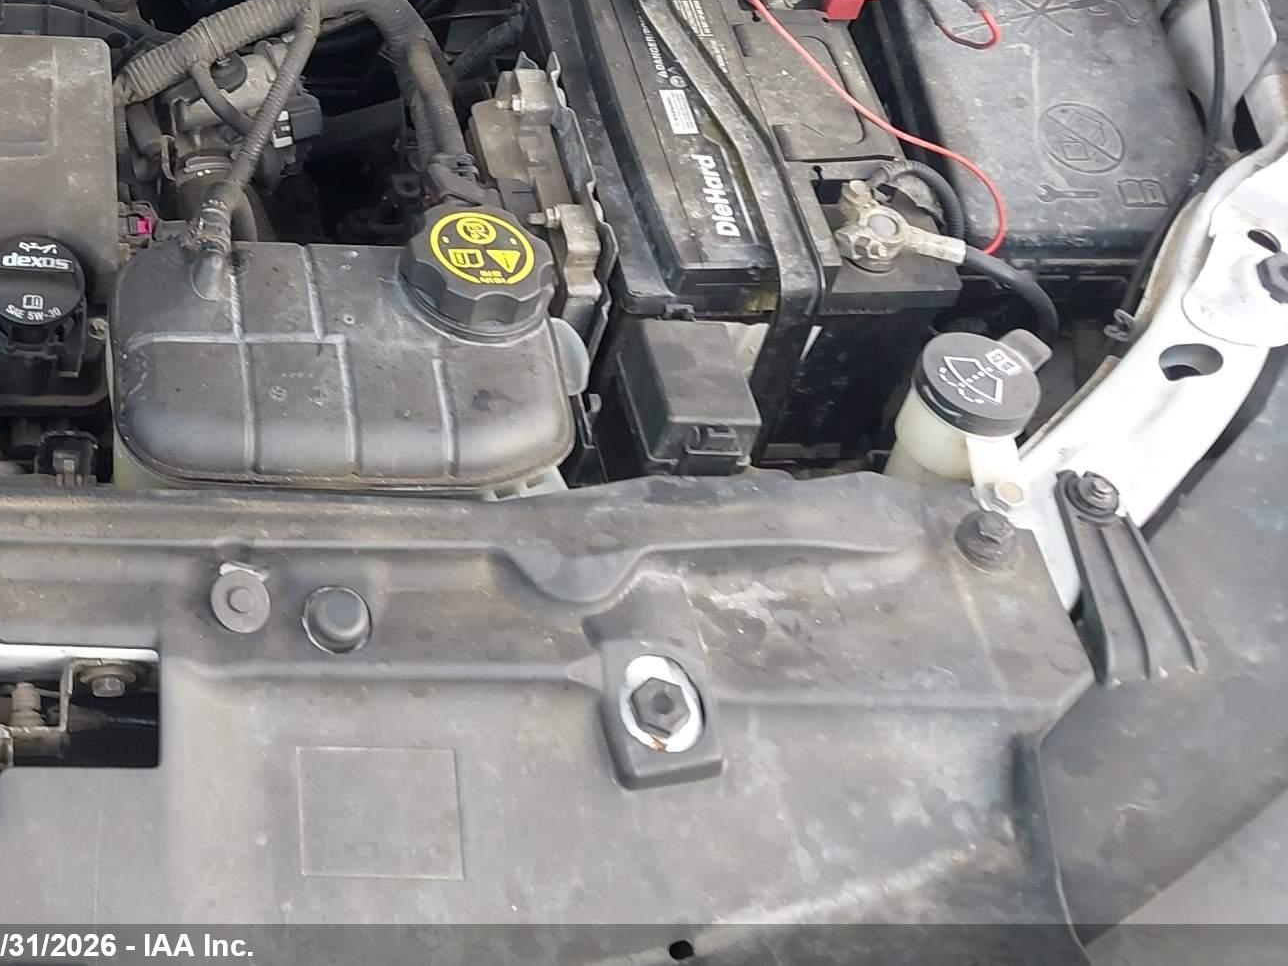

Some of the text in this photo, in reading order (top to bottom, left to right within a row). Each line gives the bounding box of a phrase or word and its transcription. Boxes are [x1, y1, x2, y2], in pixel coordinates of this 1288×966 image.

[690, 153, 741, 237] DieHard
[2, 252, 73, 270] dexos
[27, 306, 62, 321] 5W-30
